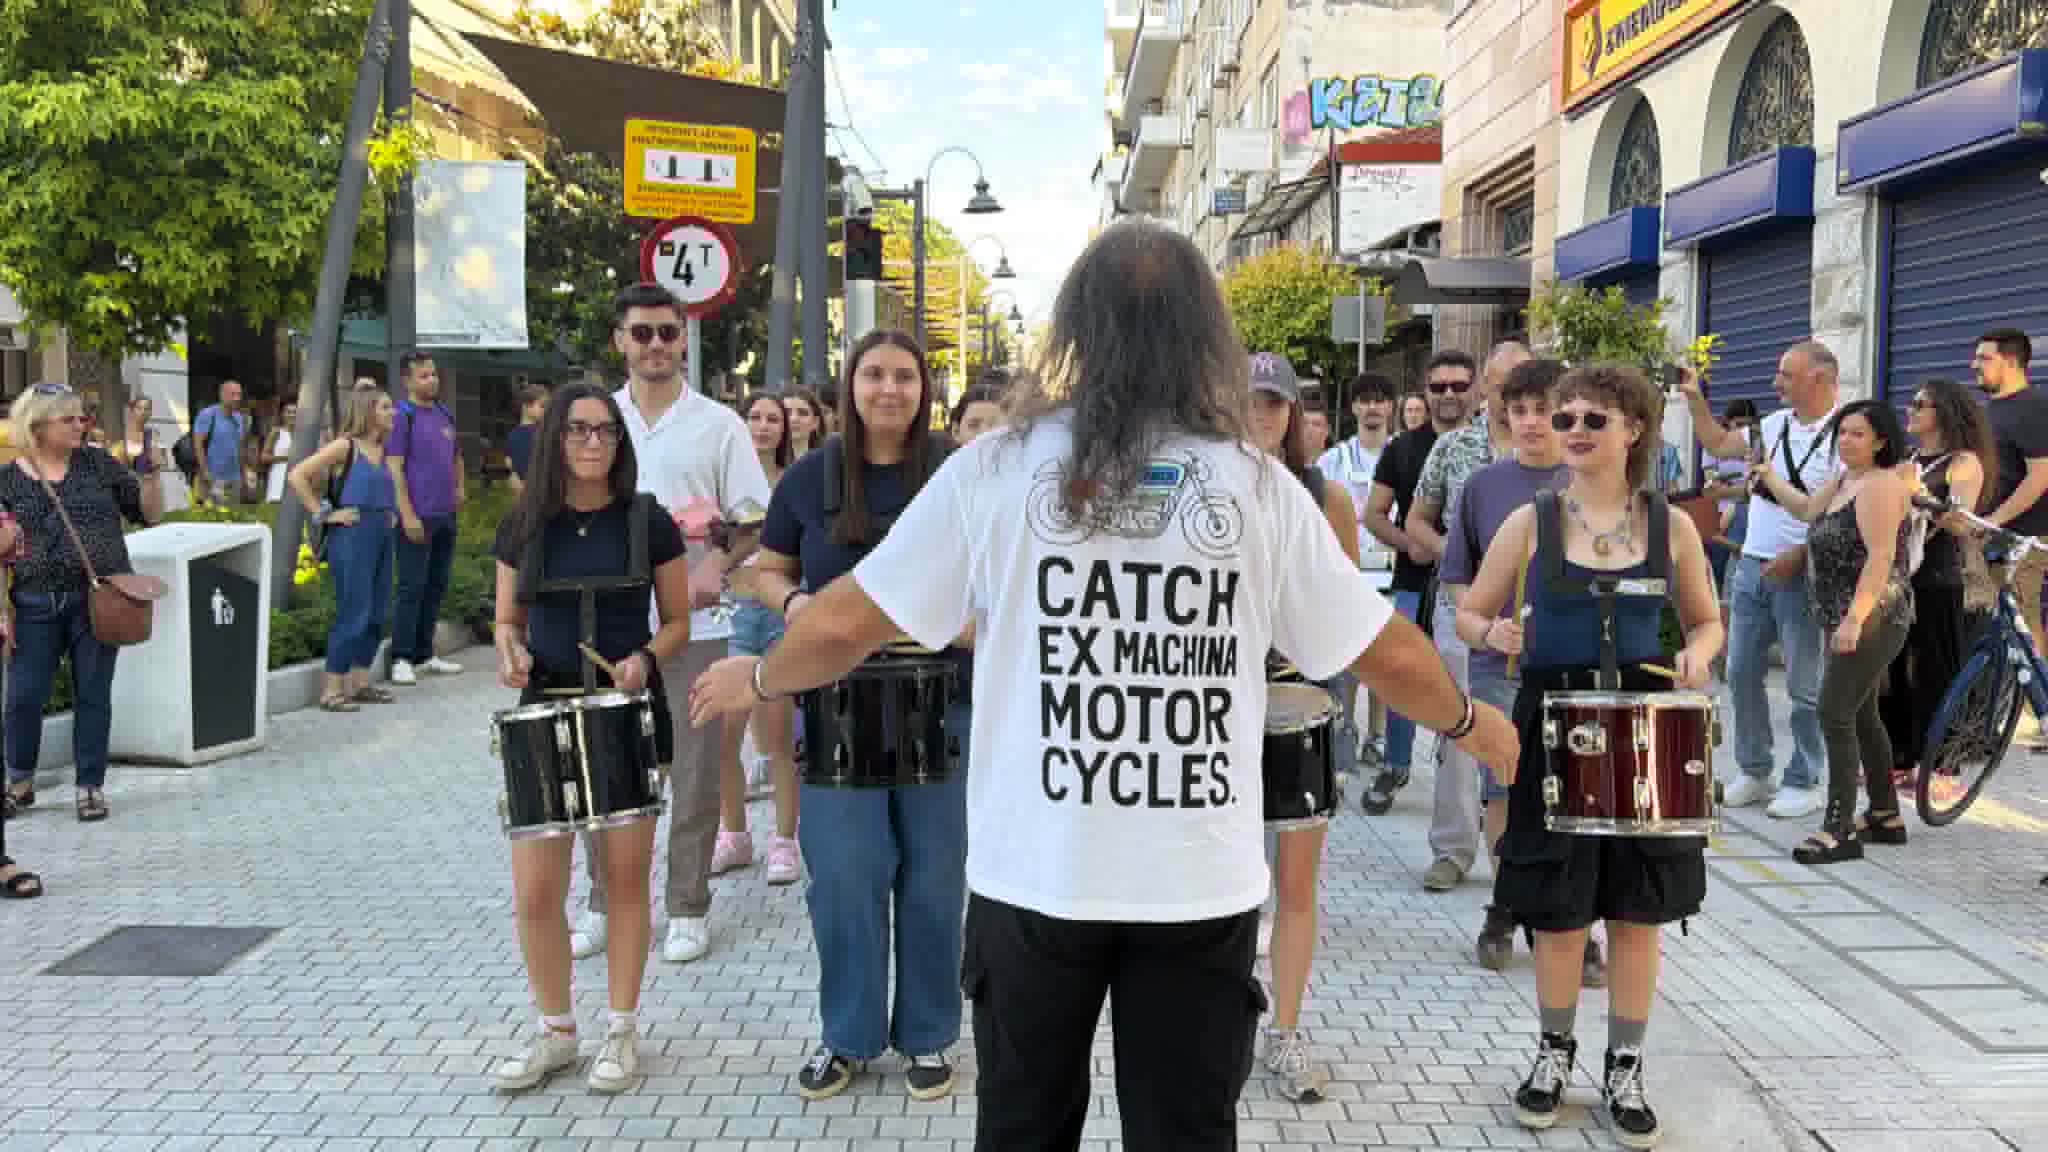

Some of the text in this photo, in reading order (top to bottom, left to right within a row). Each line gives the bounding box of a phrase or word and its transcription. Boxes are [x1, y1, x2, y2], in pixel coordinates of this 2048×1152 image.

[1037, 556, 1239, 627] CATCH
[1038, 626, 1238, 677] EX MACHINA
[1040, 681, 1232, 745] MOTOR
[1041, 746, 1237, 808] CYCLES.
